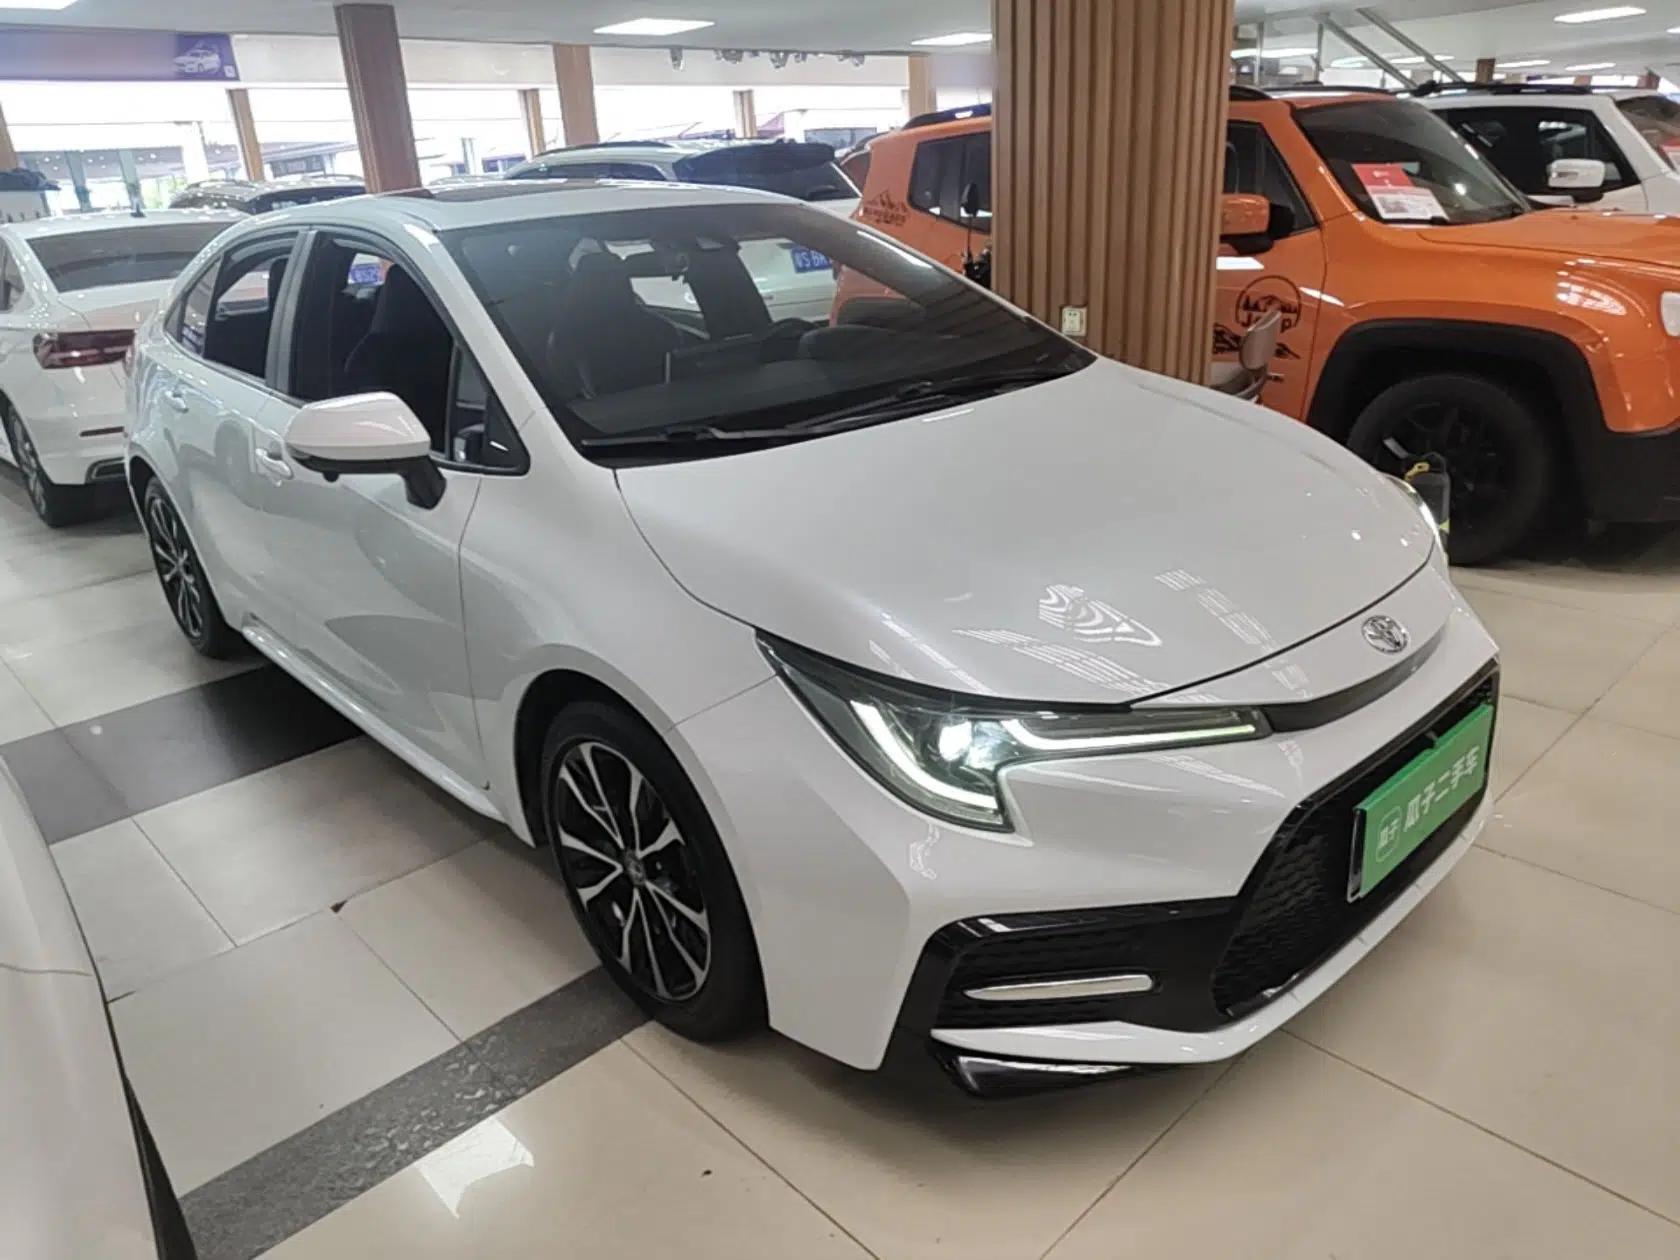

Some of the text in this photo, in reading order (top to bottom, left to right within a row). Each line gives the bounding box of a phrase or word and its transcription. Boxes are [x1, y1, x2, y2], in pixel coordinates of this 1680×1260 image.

[1403, 746, 1479, 832] 瓜子二手车
